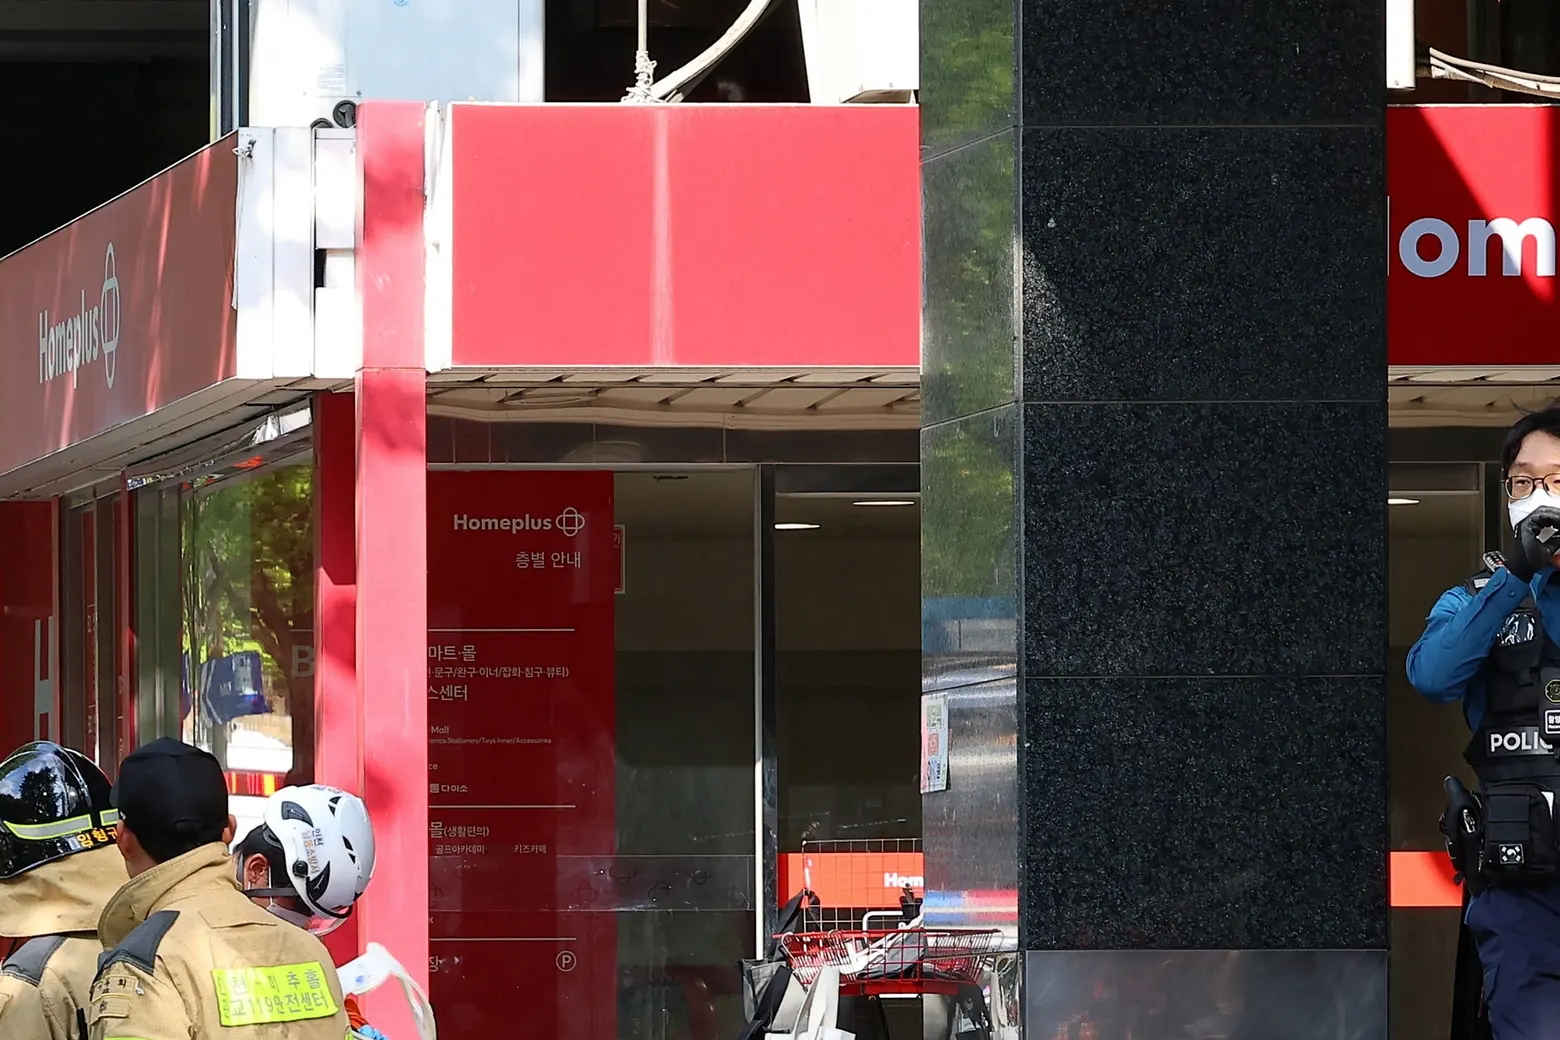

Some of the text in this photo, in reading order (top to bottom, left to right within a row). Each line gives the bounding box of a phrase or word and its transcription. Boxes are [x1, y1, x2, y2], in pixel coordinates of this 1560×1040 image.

[1387, 195, 1556, 278] om
[39, 289, 99, 389] Homeplus
[453, 514, 552, 534] Homeplus
[516, 551, 581, 569] 층별 안내
